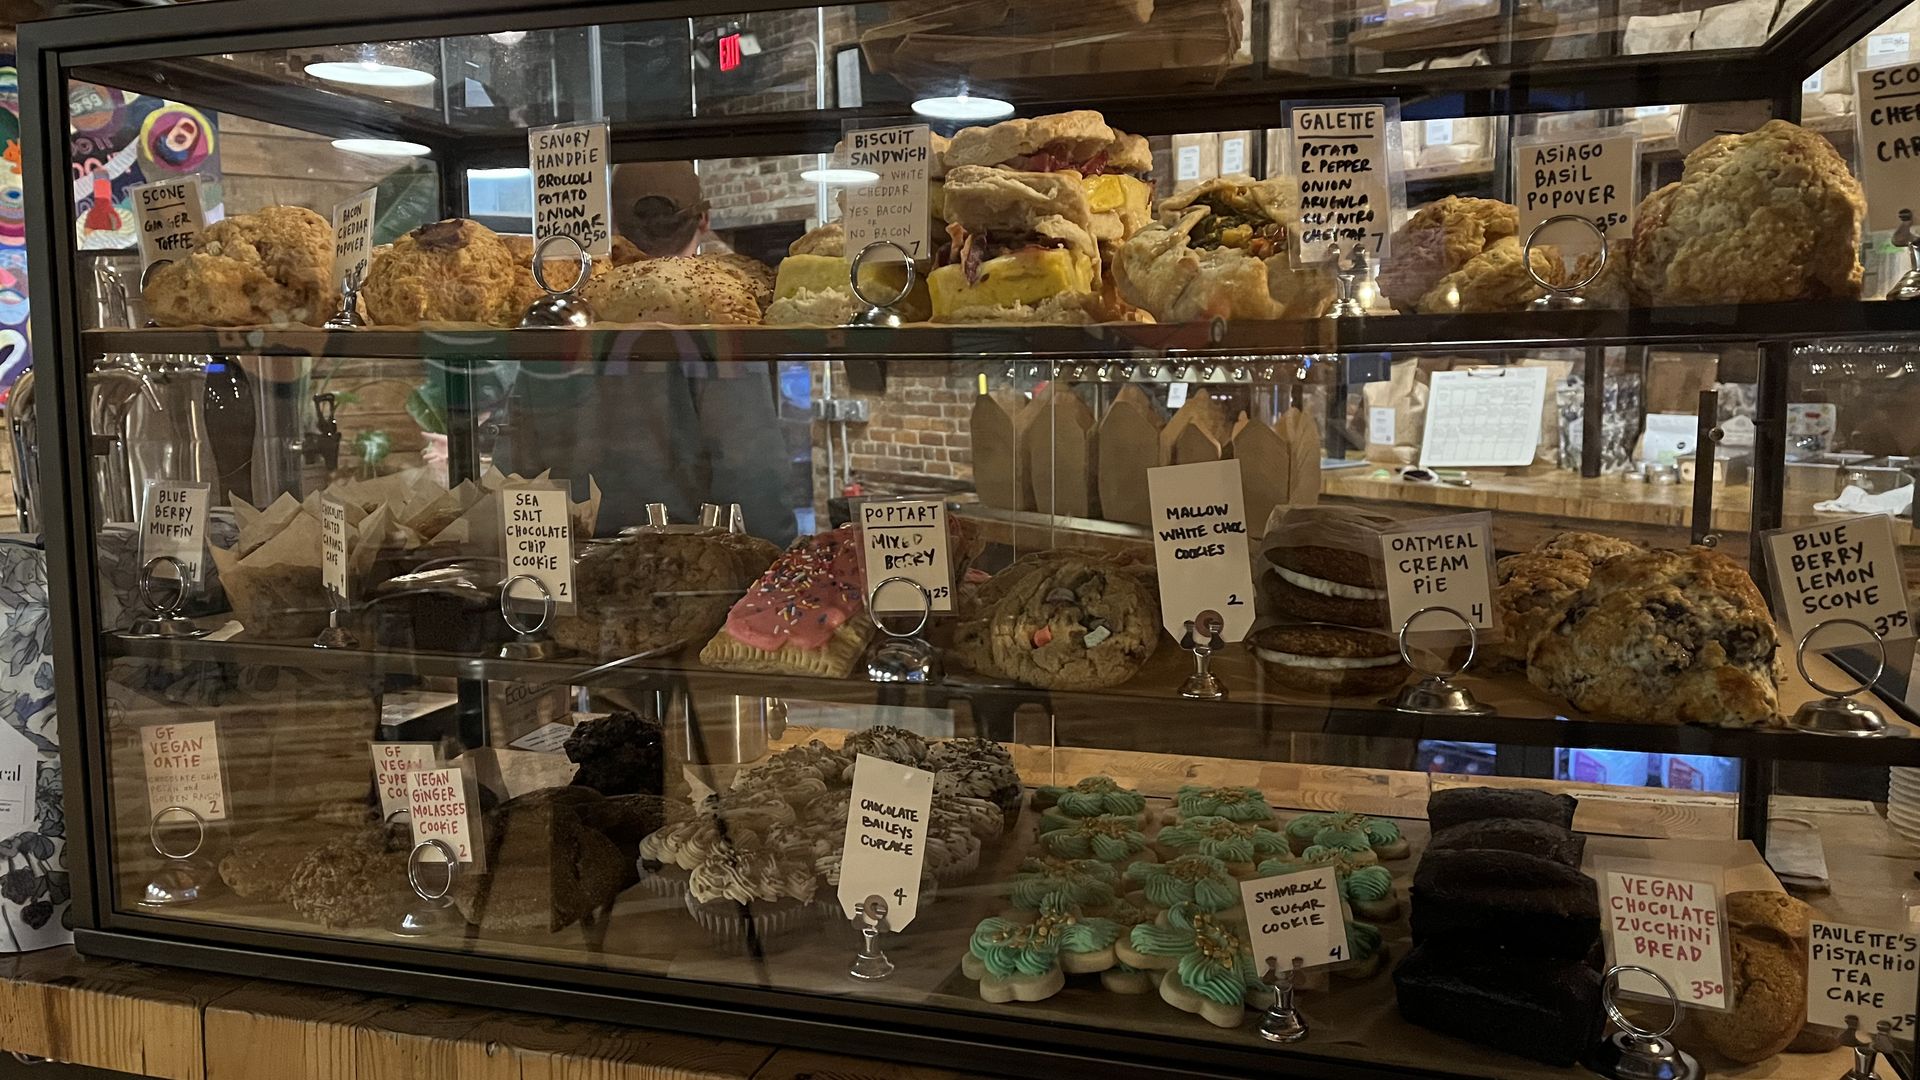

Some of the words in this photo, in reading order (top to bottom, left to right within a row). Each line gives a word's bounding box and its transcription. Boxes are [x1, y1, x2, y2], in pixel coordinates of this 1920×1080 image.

[1300, 110, 1376, 131] GALETTE
[540, 129, 590, 150] SAVORY
[1302, 142, 1359, 158] POTATO
[1319, 158, 1373, 173] PEPPER
[538, 171, 592, 190] BROCCOLI
[1301, 178, 1352, 193] ONION
[143, 184, 186, 205] SCONE
[538, 188, 587, 206] POTATO
[857, 183, 909, 198] CHEDDAR
[1527, 184, 1615, 211] POPOVER
[849, 205, 869, 218] YES
[876, 202, 913, 217] BACON
[1300, 194, 1369, 210] ARUGULA
[343, 203, 363, 222] BACON
[539, 204, 585, 222] ONION
[337, 218, 368, 240] CHEDDAR
[850, 228, 867, 240] NO
[874, 223, 911, 239] BACON
[155, 231, 194, 251] TOFFEE
[336, 236, 364, 257] POPOVER
[910, 240, 920, 255] 7
[1371, 232, 1384, 253] 7
[159, 489, 187, 503] BLUE
[515, 492, 539, 507] SEA
[155, 505, 193, 523] BERRY
[513, 508, 543, 523] SALT
[865, 504, 938, 523] POPTART
[1166, 503, 1229, 521] MALLOW
[323, 517, 341, 534] SALTED
[506, 525, 568, 539] CHOCOLATE
[1159, 524, 1208, 542] WHITE
[872, 533, 922, 550] MIXED
[1391, 532, 1479, 553] OATMEAL
[1792, 525, 1848, 552] BLUE
[326, 550, 338, 566] CAKE
[1174, 543, 1226, 560] COOKIES
[1791, 541, 1864, 573] BERRY
[189, 561, 197, 579] 4
[1399, 553, 1469, 575] CREAM
[1796, 560, 1875, 594] LEMON
[559, 582, 568, 596] 2
[1227, 593, 1244, 606] 2
[1802, 585, 1880, 615] SCONE
[1471, 603, 1483, 624] 4
[155, 726, 175, 741] GF
[150, 735, 203, 756] VEGAN
[384, 746, 401, 758] GF
[380, 758, 423, 771] VEGAN
[414, 770, 449, 787] VEGAN
[209, 799, 220, 814] 2
[412, 802, 466, 819] MOLASSES
[861, 798, 919, 822] CHOCOLATE
[862, 815, 912, 840] BAILEYS
[459, 844, 467, 858] 2
[860, 834, 913, 856] CUPCAKE
[893, 887, 907, 906] 4
[1255, 878, 1327, 904] SHAMROCK
[1621, 875, 1693, 902] VEGAN
[1271, 898, 1326, 916] SUGAR
[1611, 895, 1716, 926] CHOCOLATE
[1262, 913, 1325, 934] COOKIE
[1812, 923, 1918, 953] PAULETTE'S
[1328, 944, 1342, 960] 4
[1634, 935, 1702, 962] BREAD
[1831, 967, 1872, 987] TEA
[1690, 980, 1724, 1000] 350
[1826, 986, 1885, 1008] CAKE
